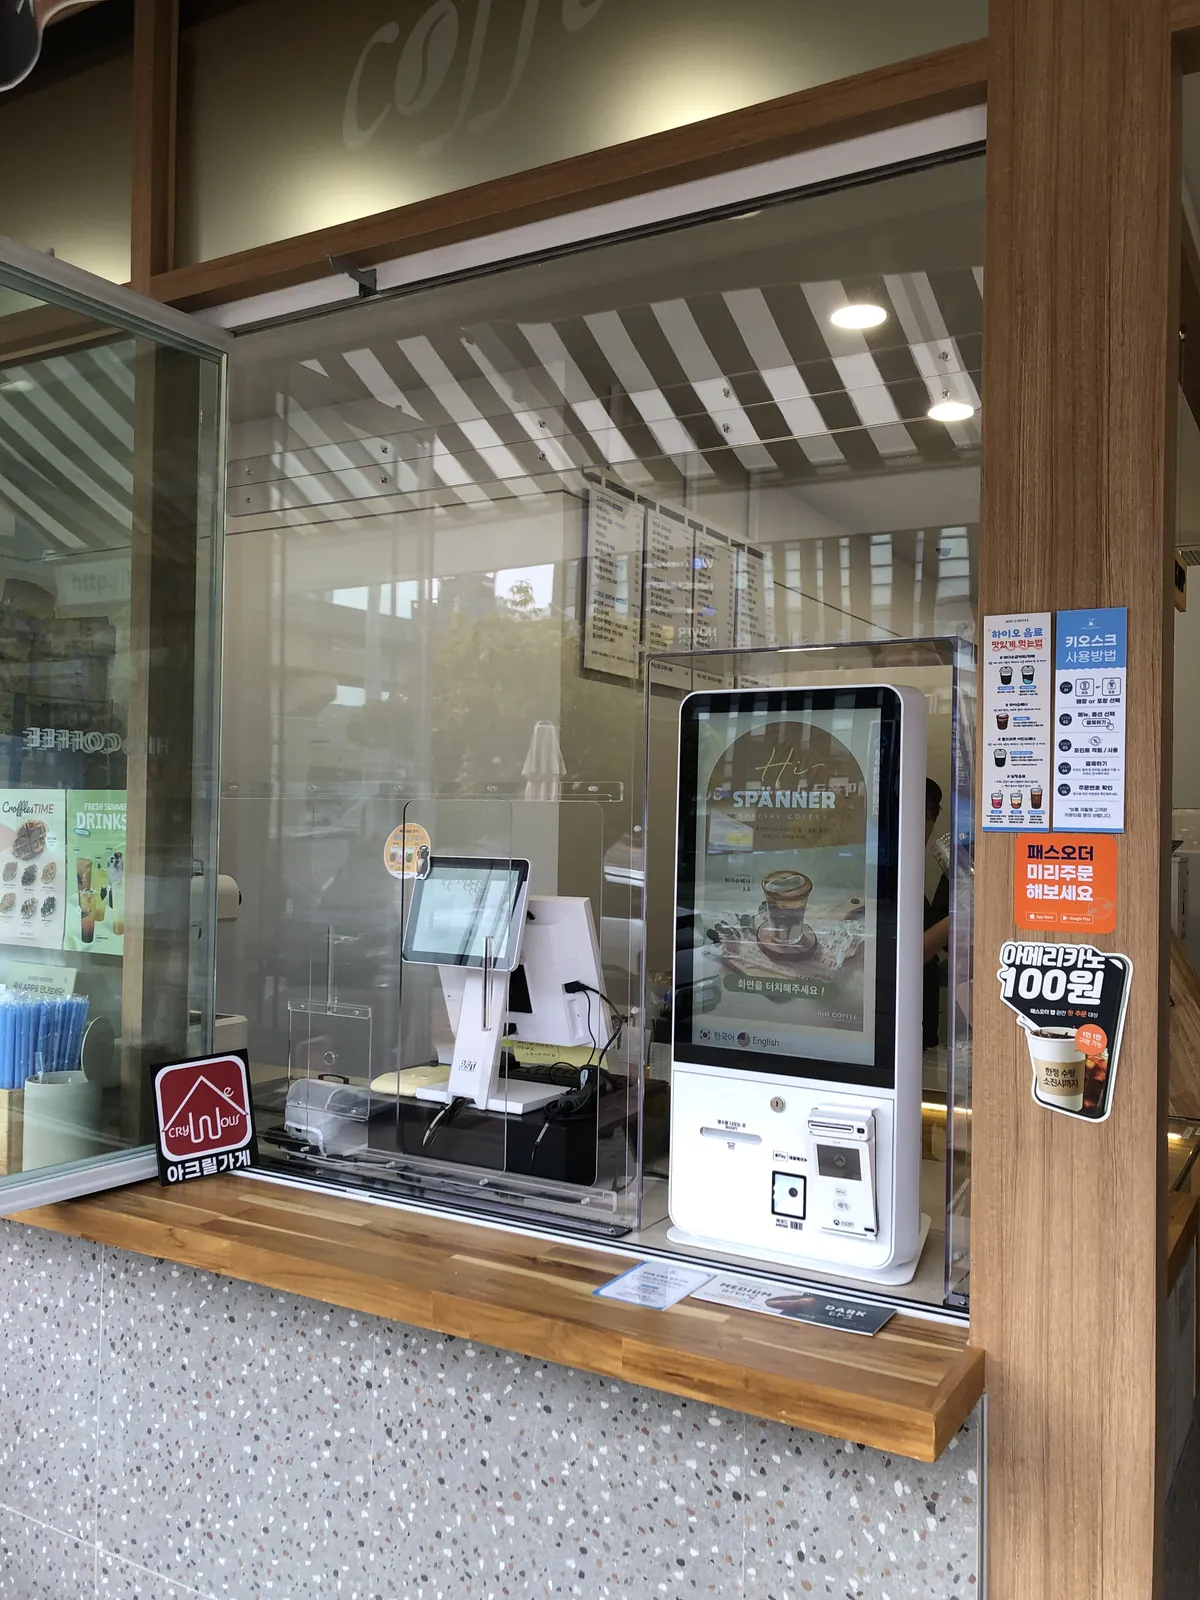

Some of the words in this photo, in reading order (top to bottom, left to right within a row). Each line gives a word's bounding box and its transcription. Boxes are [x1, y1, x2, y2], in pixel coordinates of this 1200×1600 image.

[992, 629, 1021, 638] 하이오
[1024, 627, 1043, 638] 음료
[992, 640, 1016, 649] 맛있게
[1018, 639, 1043, 648] 먹는법
[1065, 634, 1117, 648] 키오스크
[1065, 650, 1116, 663] 사용방법
[733, 786, 836, 809] SPÄNNER
[1027, 845, 1093, 861] 패스오더
[1027, 864, 1094, 881] 미리주문
[1026, 884, 1093, 901] 해보세요
[1002, 944, 1106, 969] 아메리카노
[737, 978, 763, 991] 화면을
[765, 982, 819, 995] 터치해주세요
[1000, 966, 1104, 1005] 100원
[1075, 1009, 1087, 1017] 주문
[714, 1032, 734, 1042] 한국어
[753, 1036, 780, 1047] English
[1091, 1040, 1102, 1048] 가능
[1045, 1067, 1059, 1077] 한정
[1061, 1068, 1076, 1078] 수량
[1043, 1078, 1079, 1088] 소진시까지
[167, 1149, 251, 1182] 아크릴가게
[720, 1282, 772, 1297] MEDIUM
[825, 1304, 867, 1318] DARK
